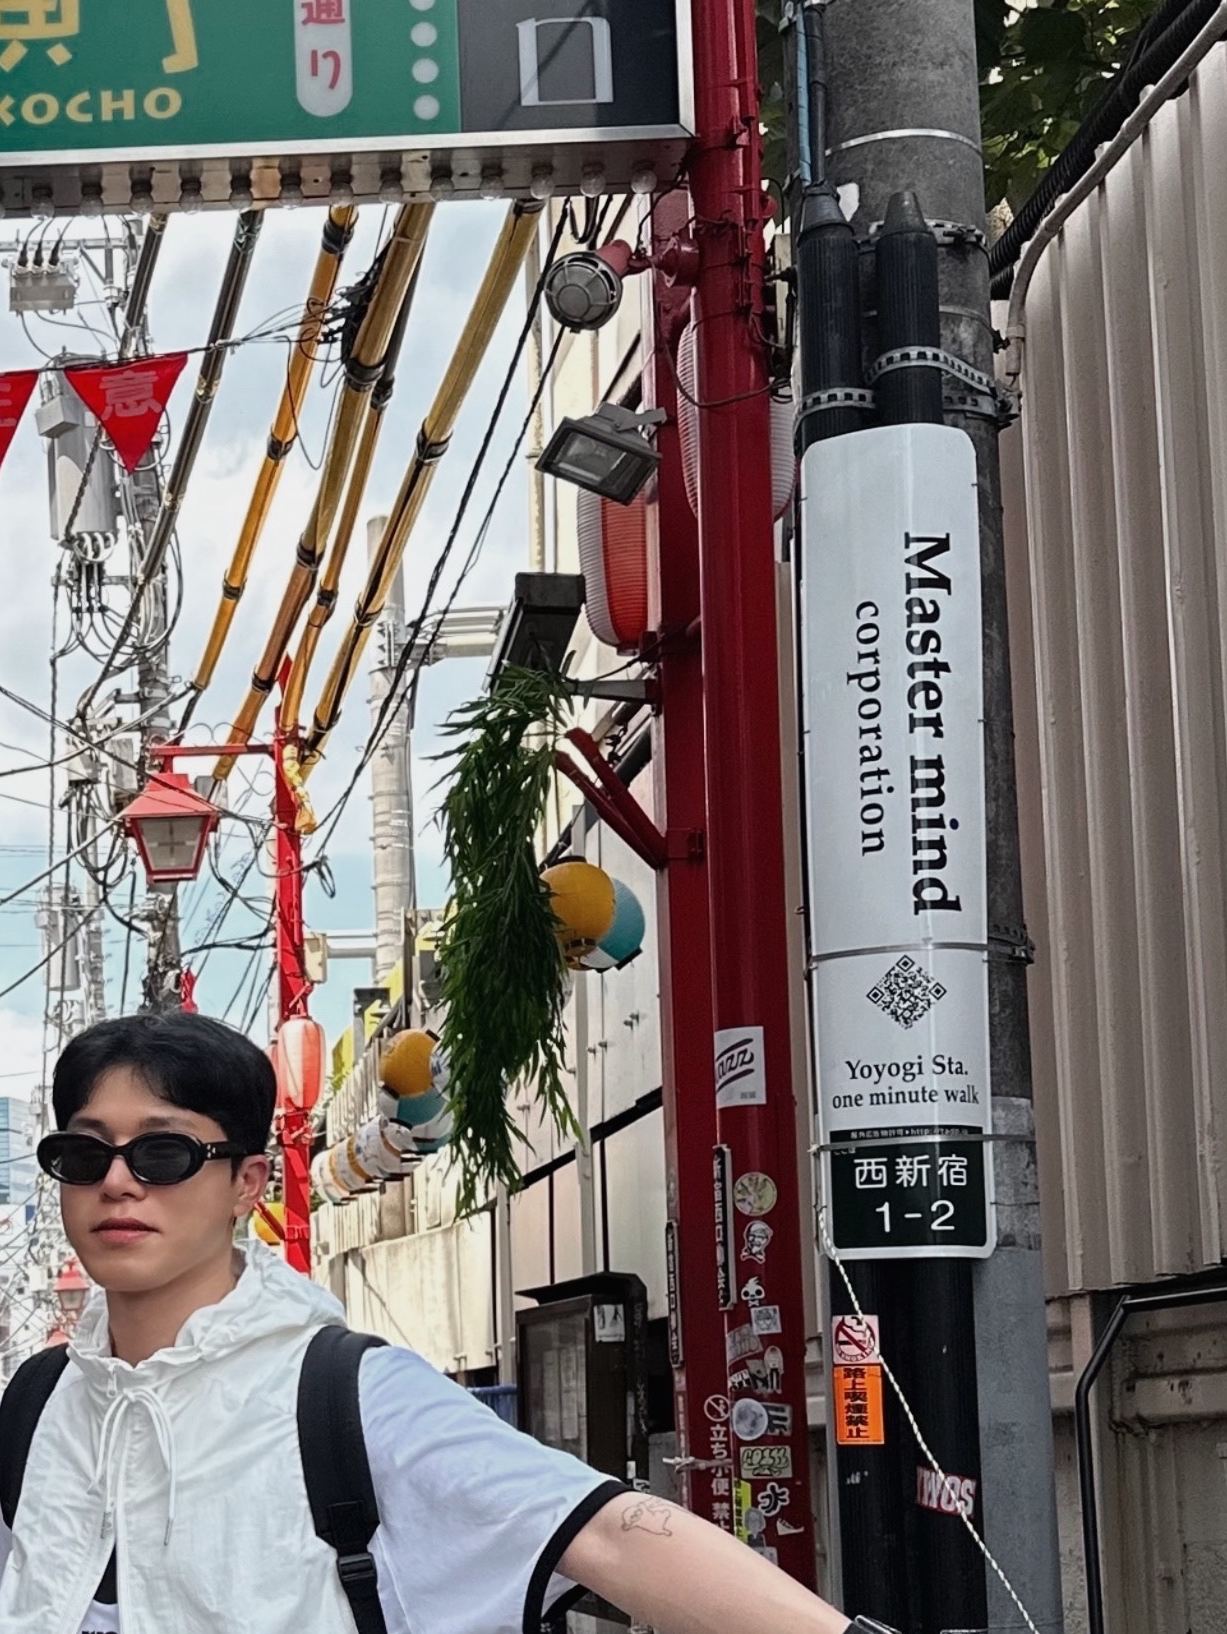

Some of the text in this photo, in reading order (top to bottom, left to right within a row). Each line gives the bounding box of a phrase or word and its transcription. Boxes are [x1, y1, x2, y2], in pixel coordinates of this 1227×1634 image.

[846, 600, 895, 857] corporation
[902, 532, 962, 916] Master mind
[844, 1054, 969, 1085] Yoyogi Sta.
[832, 1084, 980, 1109] one minute walk
[853, 1153, 969, 1190] 西新宿
[875, 1200, 956, 1233] 1-2
[842, 1367, 871, 1439] 路上喫煙禁止
